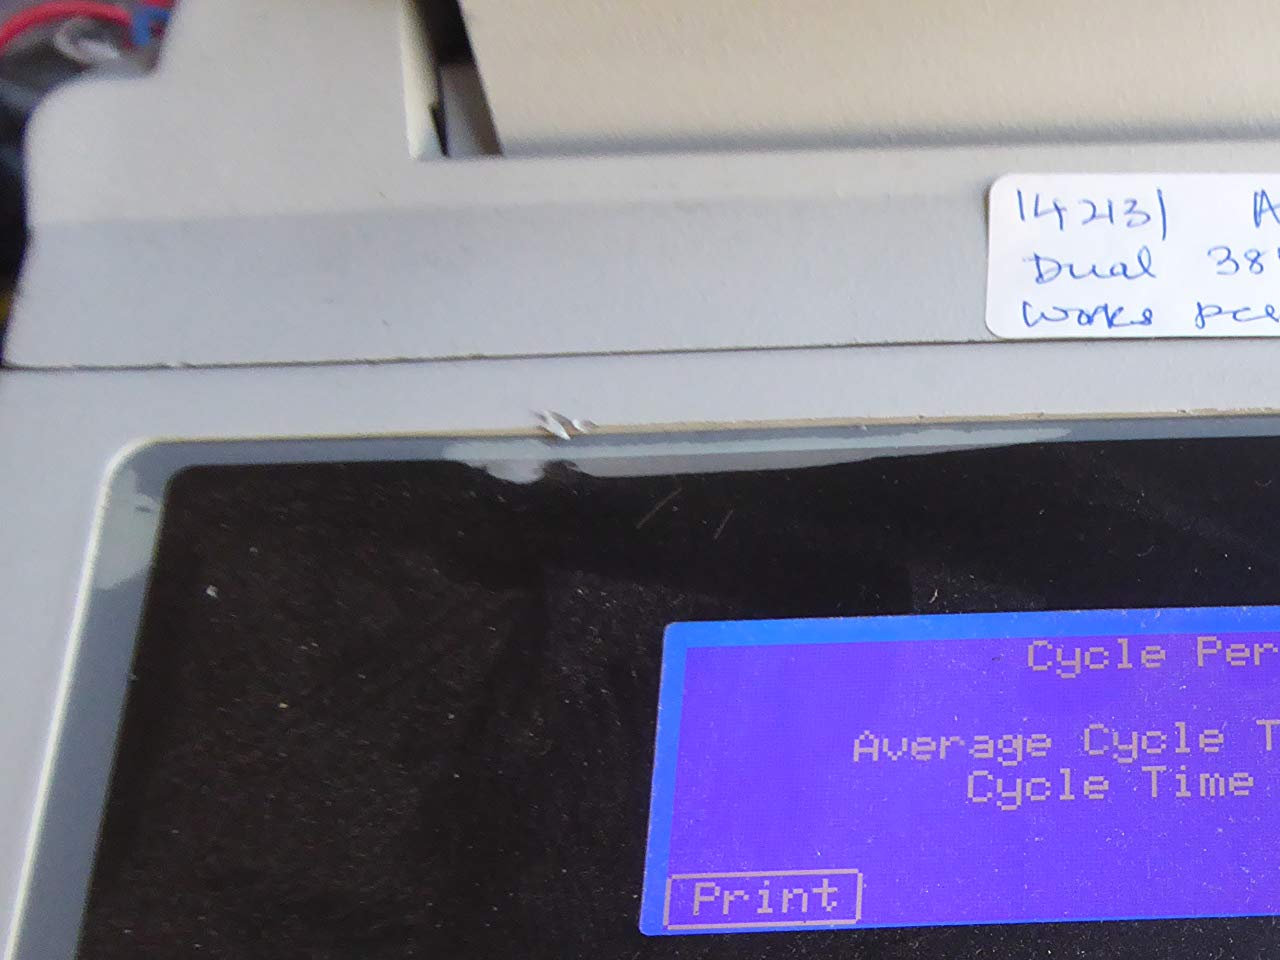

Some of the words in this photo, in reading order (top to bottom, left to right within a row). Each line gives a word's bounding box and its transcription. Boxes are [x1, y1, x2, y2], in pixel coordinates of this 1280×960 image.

[1023, 245, 1156, 284] Dual
[1026, 637, 1167, 679] Cycle
[853, 730, 1052, 766] Average
[1083, 722, 1225, 764] Cycle
[967, 770, 1110, 811] Cycle
[1141, 765, 1254, 799] Time
[692, 878, 840, 917] Print
